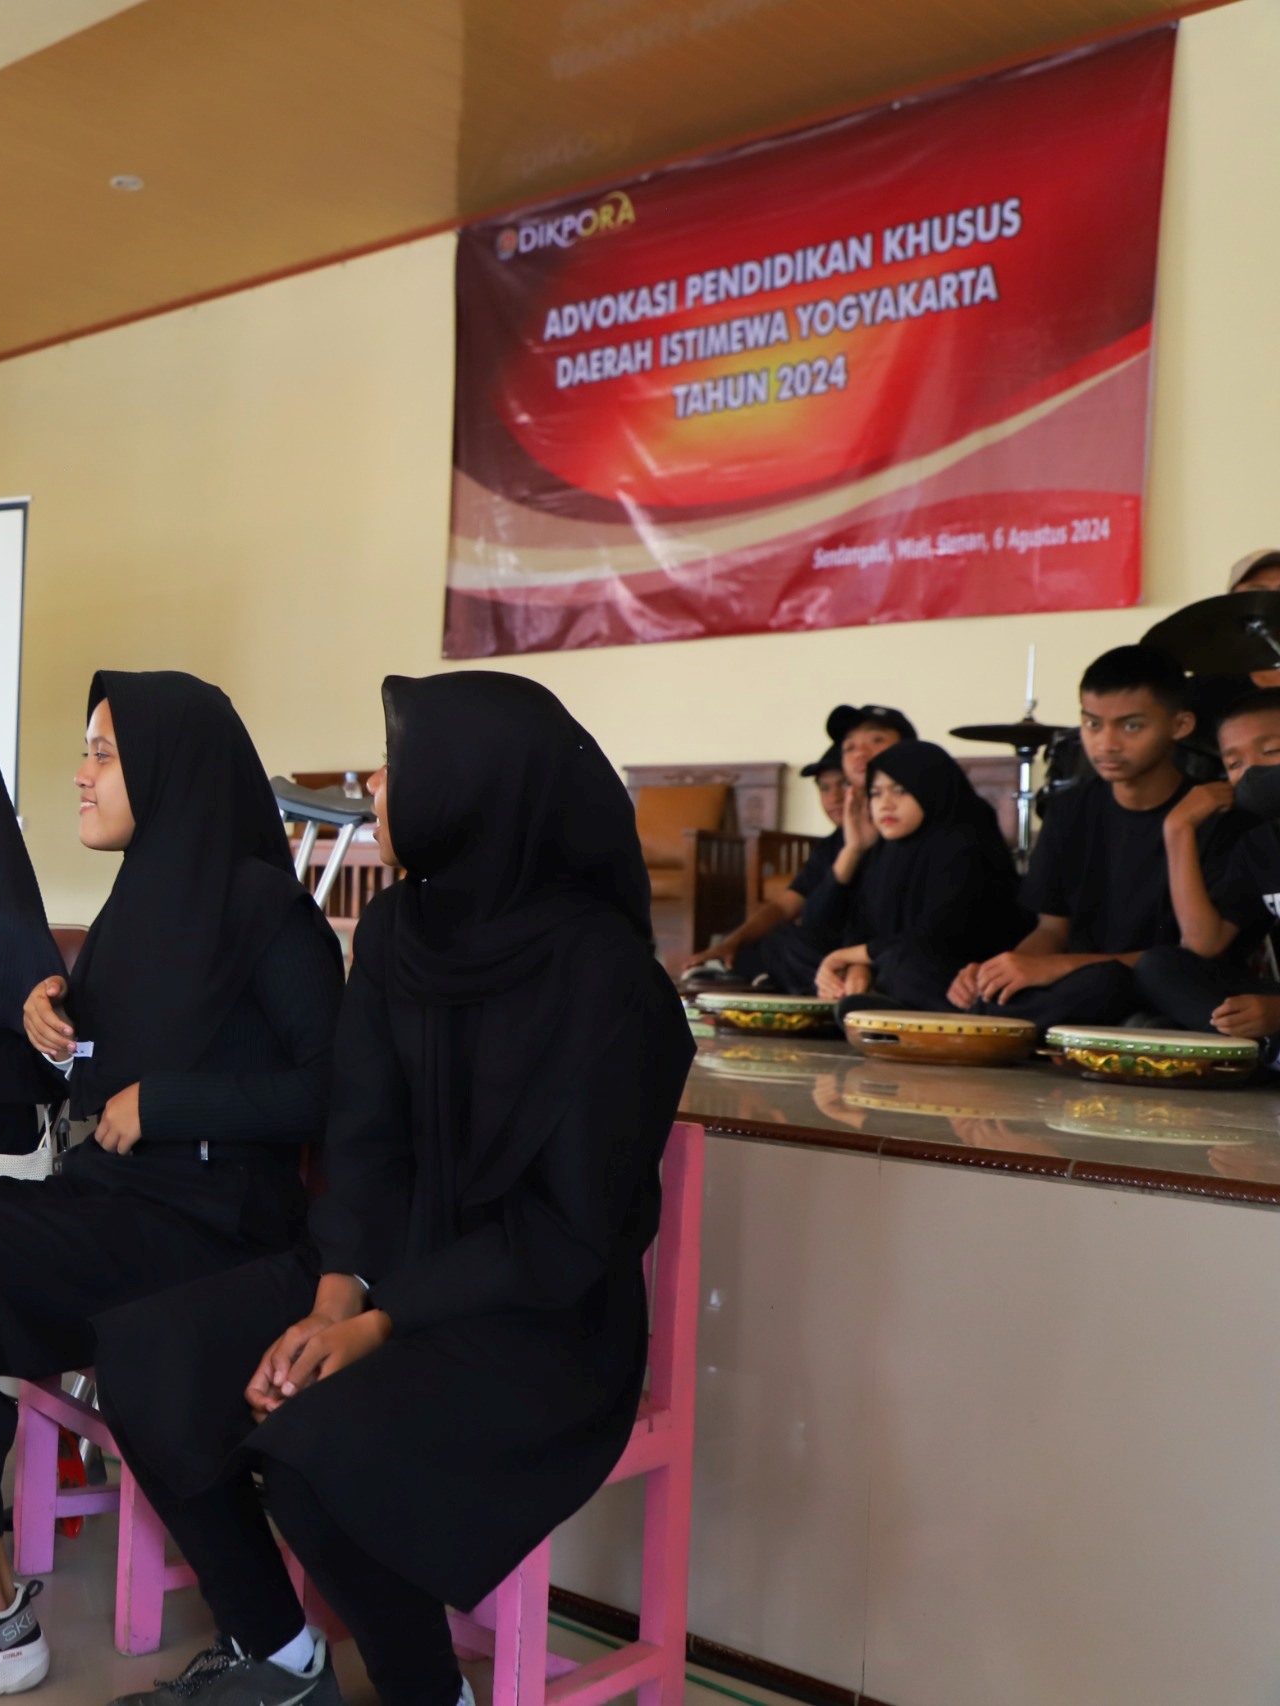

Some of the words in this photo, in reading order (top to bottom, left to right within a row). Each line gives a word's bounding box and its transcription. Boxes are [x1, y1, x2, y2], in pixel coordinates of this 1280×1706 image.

[519, 190, 636, 254] DIKPORA
[543, 280, 678, 342] ADVOKASI
[685, 232, 873, 310] PENDIDIKAN
[882, 197, 1022, 265] KHUSUS
[555, 338, 653, 390] DAERAH
[660, 309, 790, 368] ISTIMEWA
[796, 264, 999, 340] YOGYAKARTA
[671, 368, 769, 419] TAHUN
[776, 354, 848, 401] 2024
[993, 526, 1005, 551] 6
[1007, 523, 1068, 555] Agustus
[1071, 517, 1111, 544] 2024
